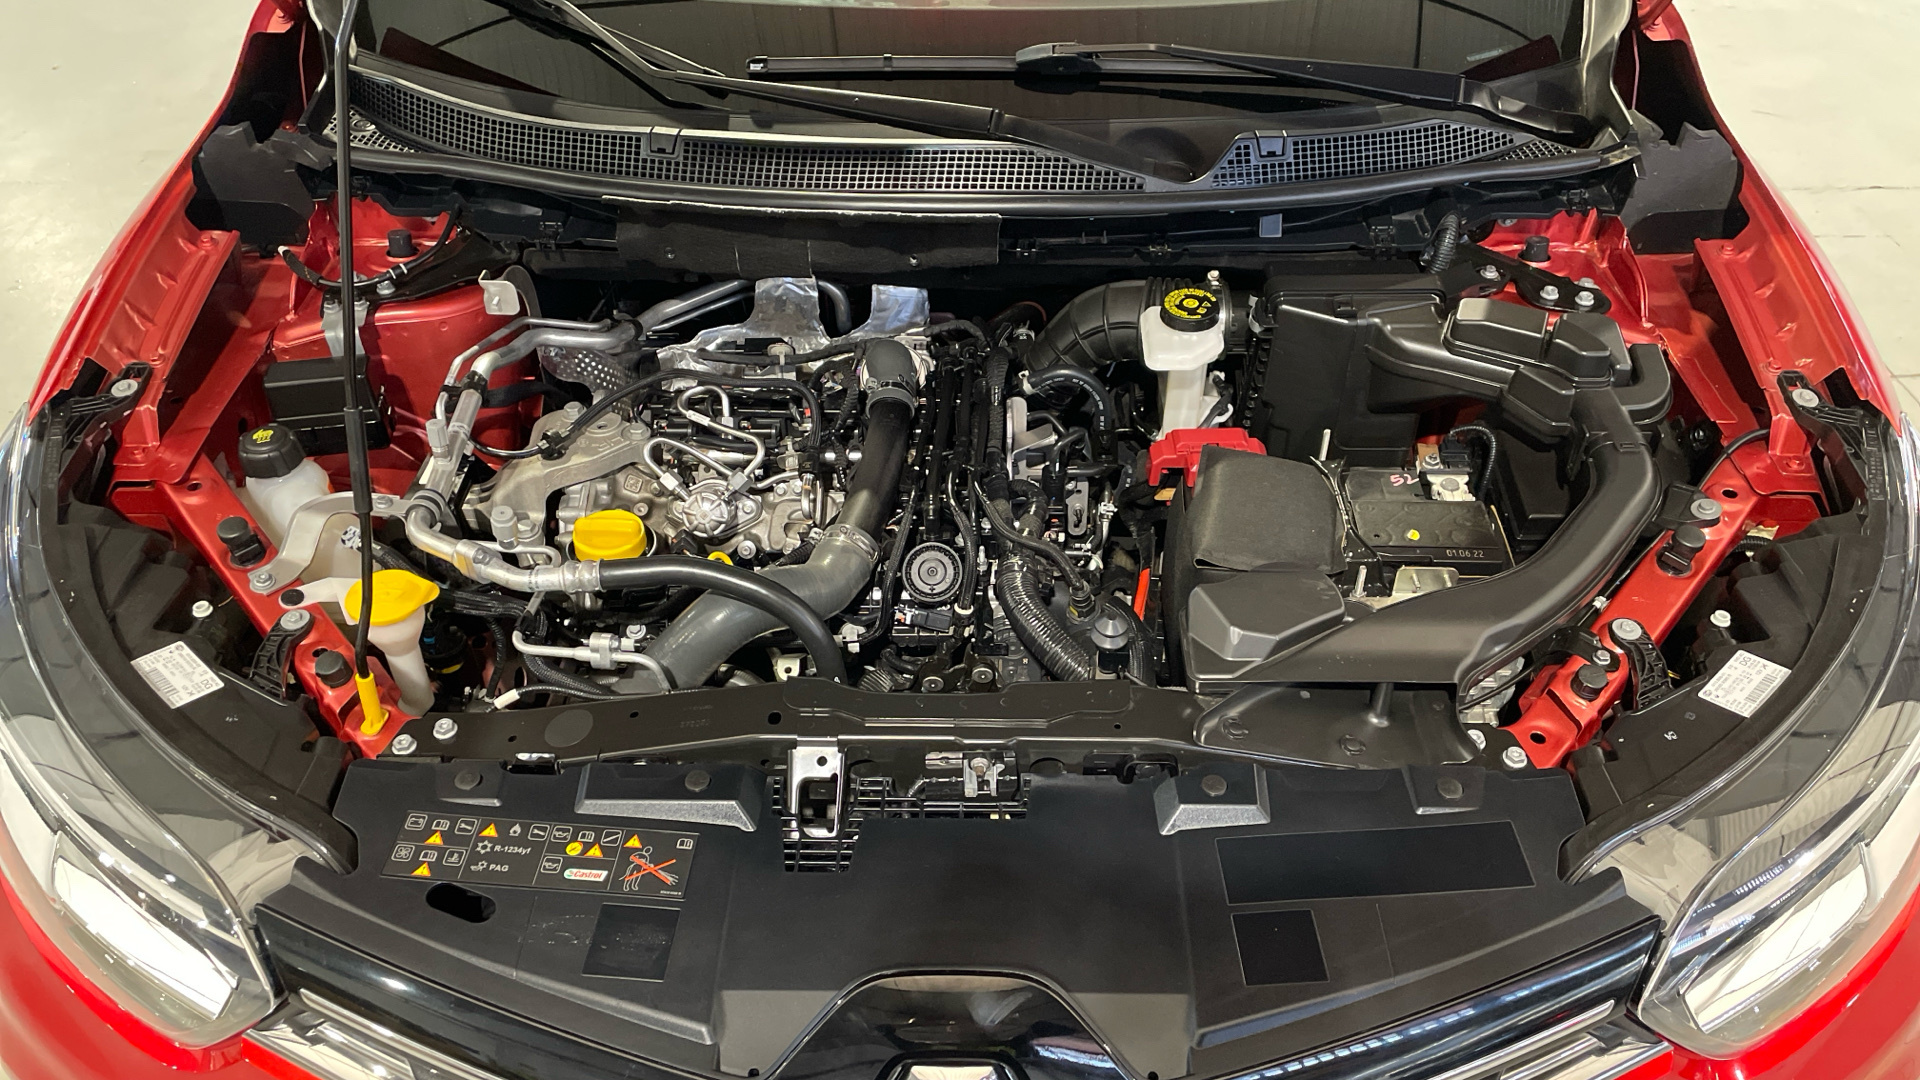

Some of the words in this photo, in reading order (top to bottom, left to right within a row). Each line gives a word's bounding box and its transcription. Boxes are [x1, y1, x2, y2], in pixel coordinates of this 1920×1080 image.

[1390, 474, 1420, 487] 52
[493, 845, 532, 856] R-1234yf
[488, 863, 509, 872] PAG
[573, 870, 603, 879] Castrol
